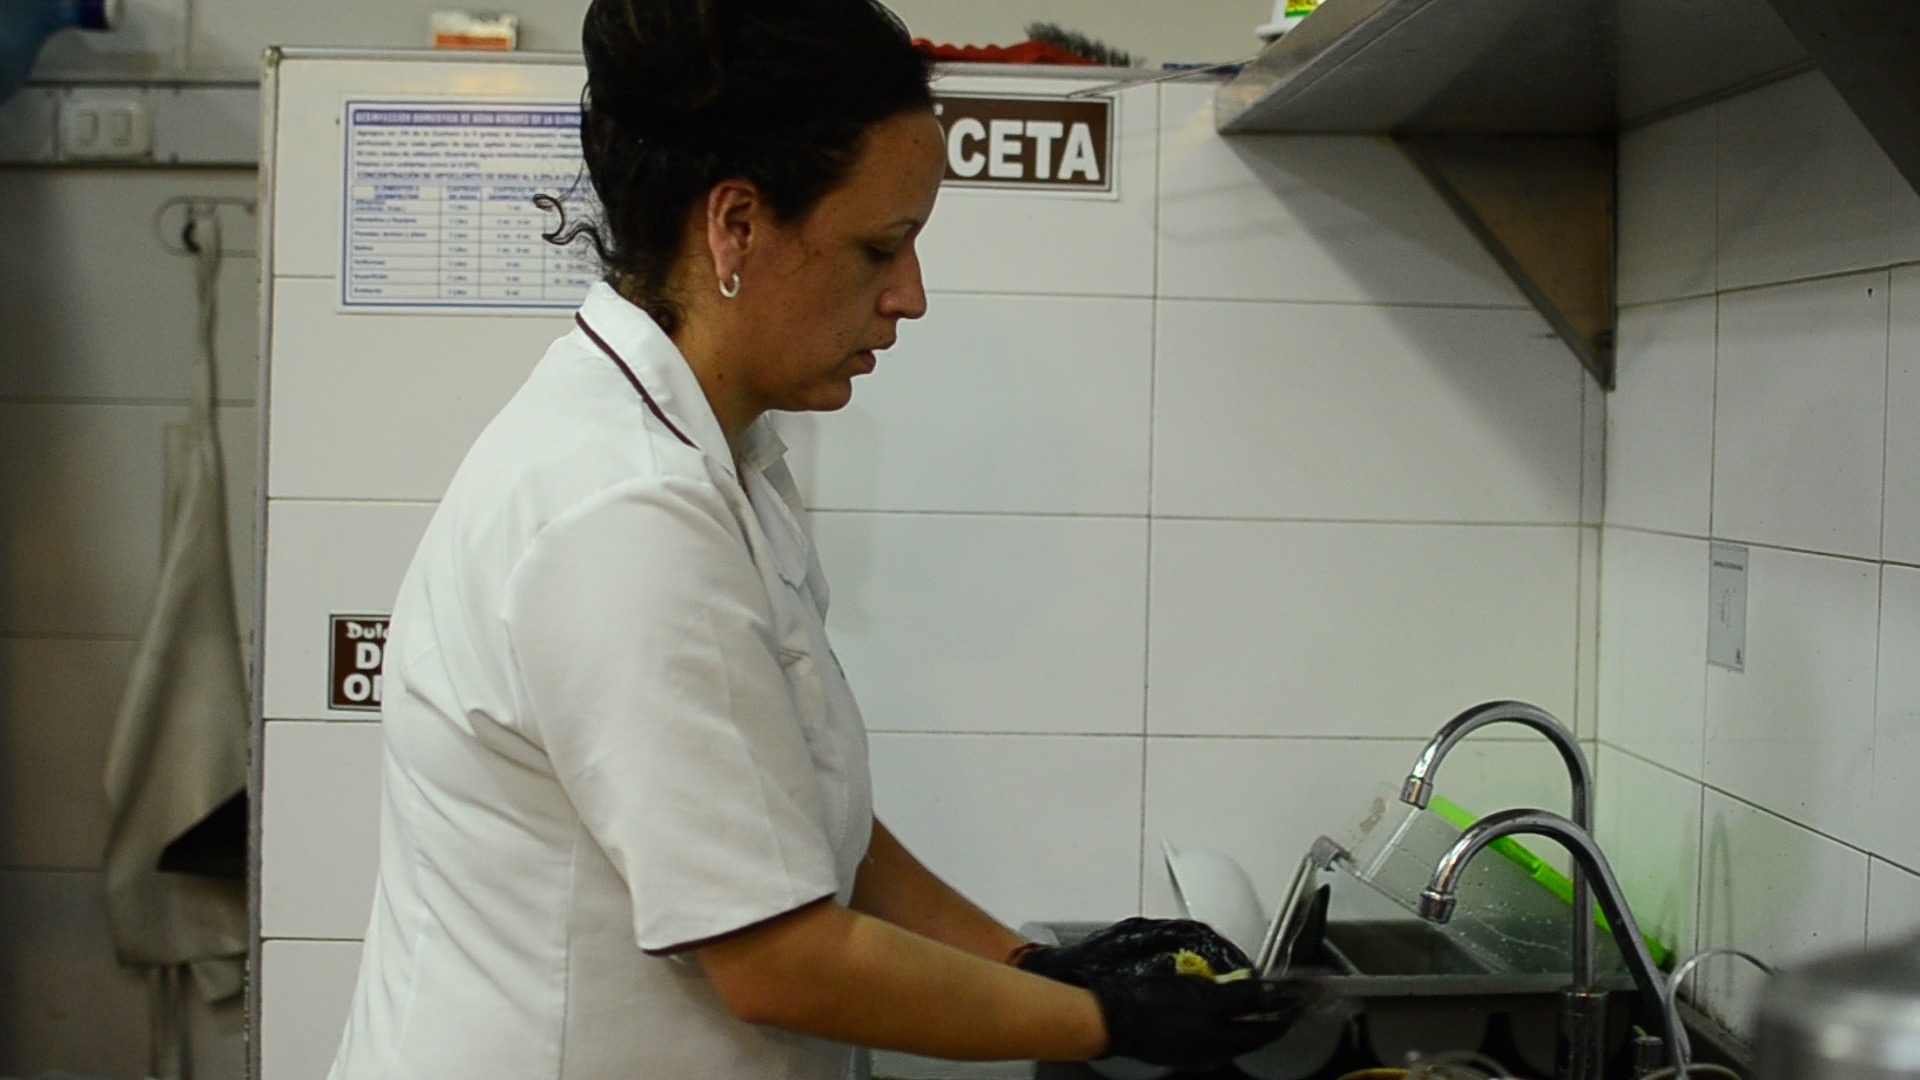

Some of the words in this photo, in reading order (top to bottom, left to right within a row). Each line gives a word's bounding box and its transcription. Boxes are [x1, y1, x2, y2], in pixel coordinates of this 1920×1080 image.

[947, 117, 1100, 181] CETA
[346, 621, 390, 639] Dulc
[356, 642, 382, 670] D
